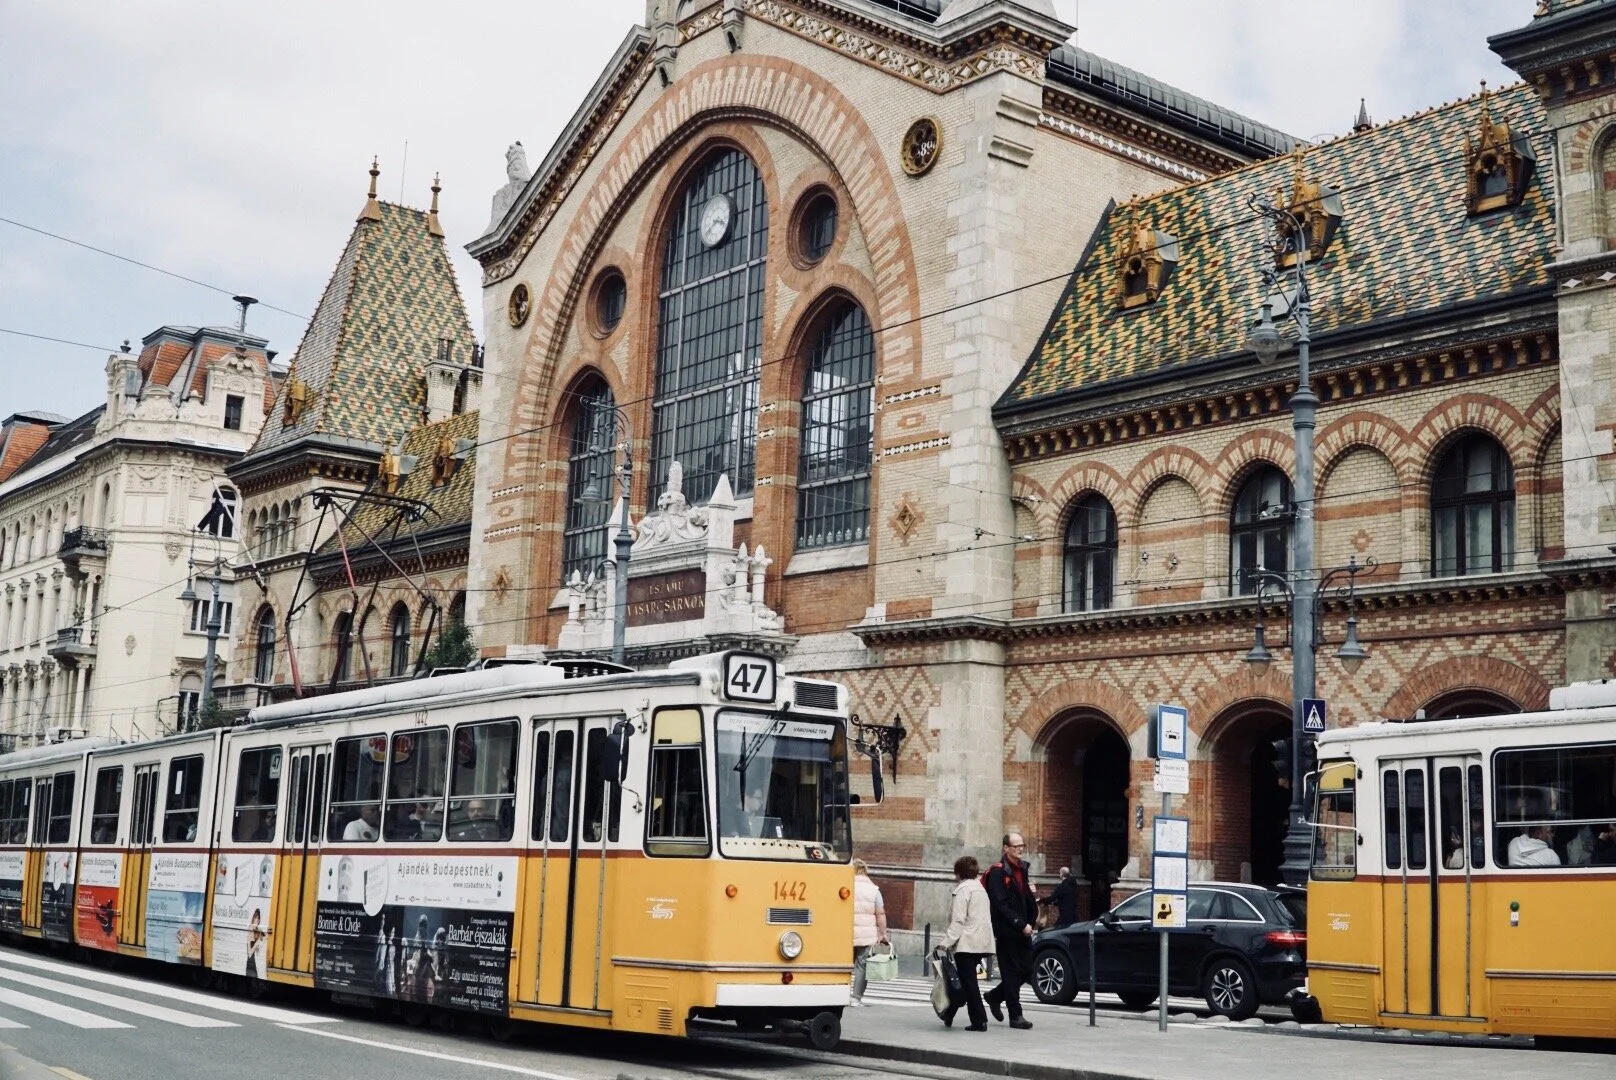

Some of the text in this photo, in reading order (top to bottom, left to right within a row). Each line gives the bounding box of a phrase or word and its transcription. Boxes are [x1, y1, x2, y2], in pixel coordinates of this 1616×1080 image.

[731, 663, 767, 694] 47
[397, 862, 430, 878] Ajándék
[433, 863, 493, 879] Budapestnek!
[774, 881, 806, 901] 1442
[318, 915, 361, 934] Bonnie & Clyde
[448, 924, 507, 946] Barbár éjszakák
